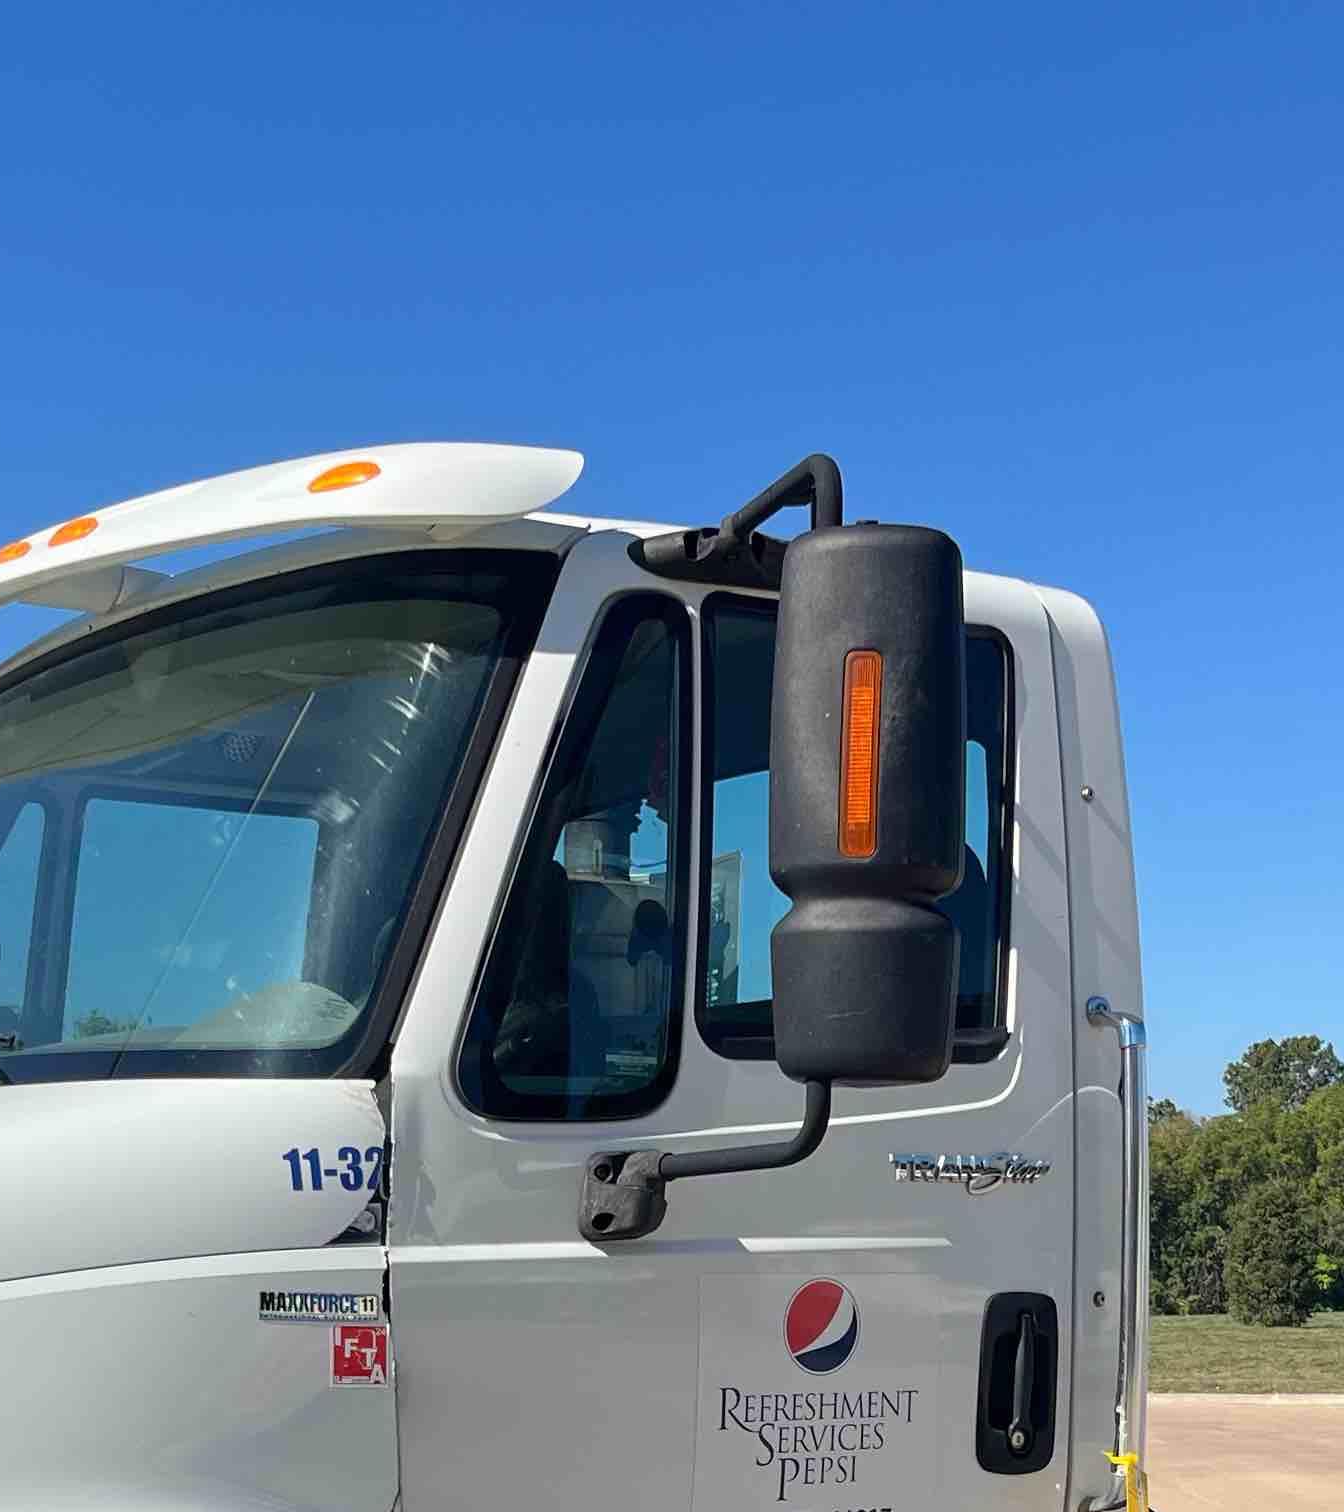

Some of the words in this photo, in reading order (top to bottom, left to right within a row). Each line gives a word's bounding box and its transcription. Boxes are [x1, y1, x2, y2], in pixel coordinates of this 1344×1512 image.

[259, 1291, 359, 1314] MAXXFORCE
[718, 1387, 919, 1432] REFRESHMENT
[756, 1422, 885, 1466] SERVICES
[776, 1455, 857, 1501] PEPSI
